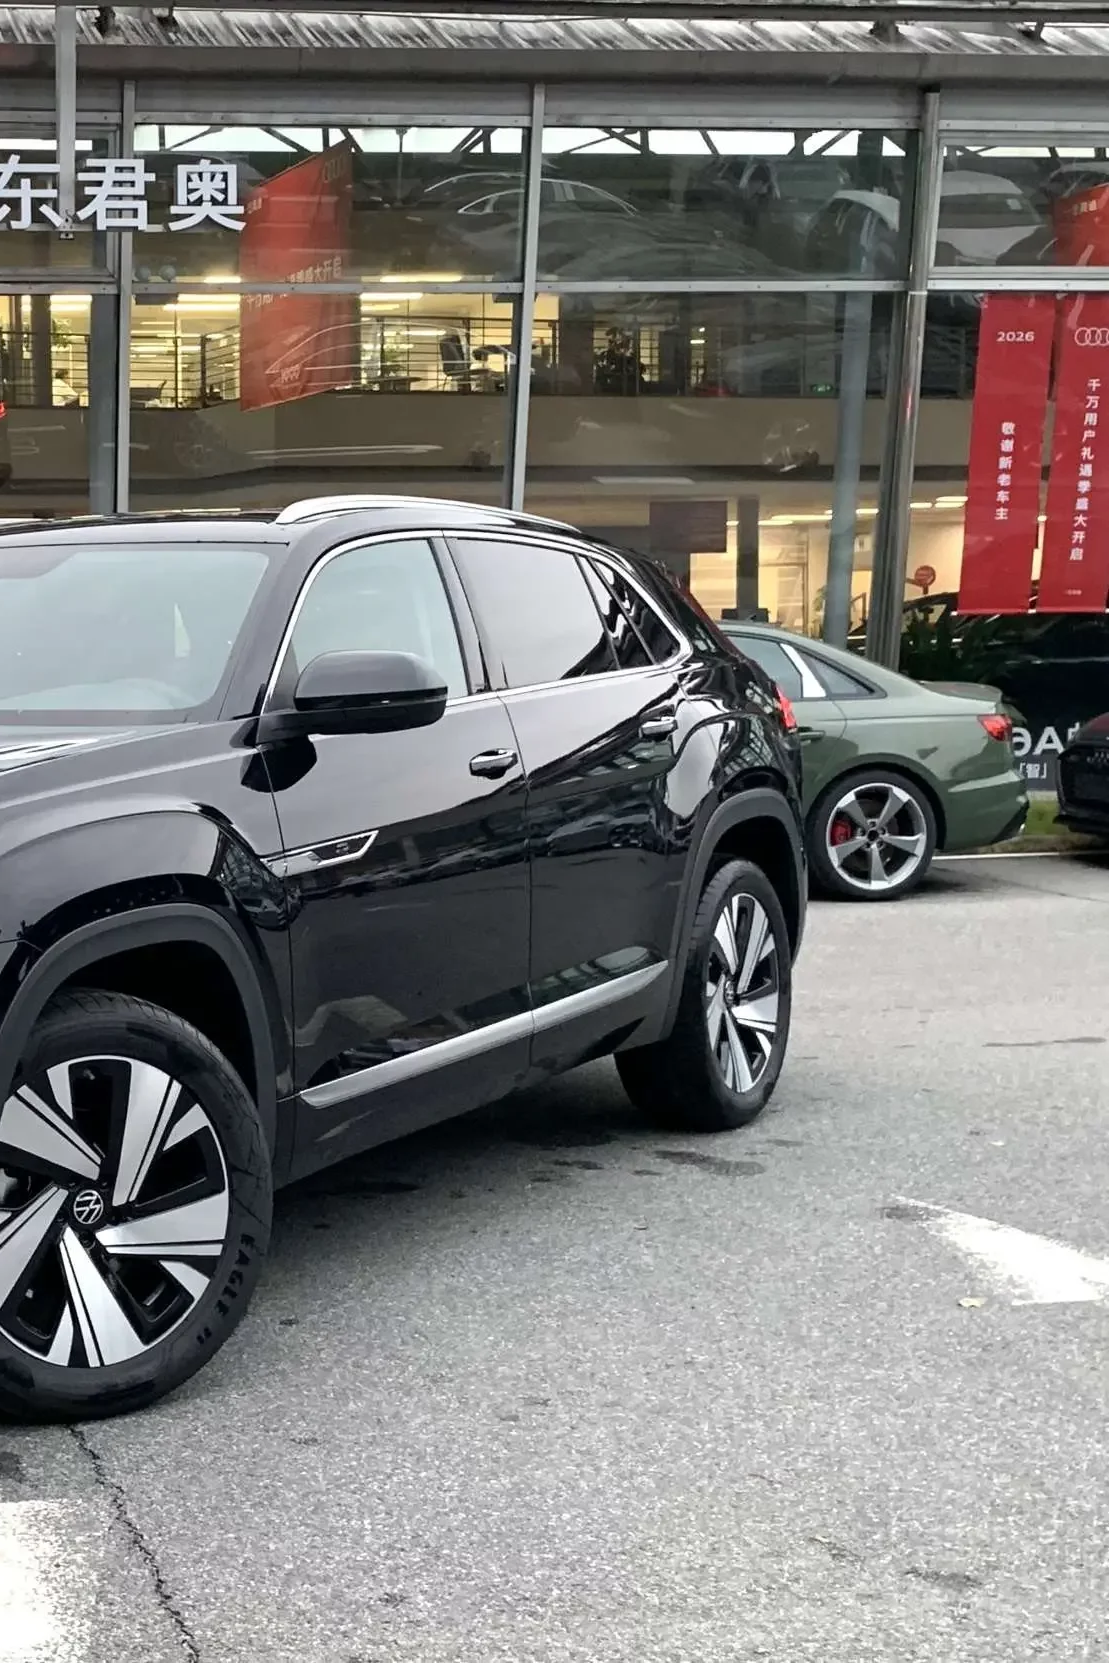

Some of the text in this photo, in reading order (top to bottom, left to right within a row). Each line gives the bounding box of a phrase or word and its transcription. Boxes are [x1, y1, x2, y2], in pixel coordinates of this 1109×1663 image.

[996, 331, 1035, 342] 2026
[994, 421, 1016, 521] 敬谢新老车主
[1069, 378, 1101, 561] 千万用户礼遇季盛大开启
